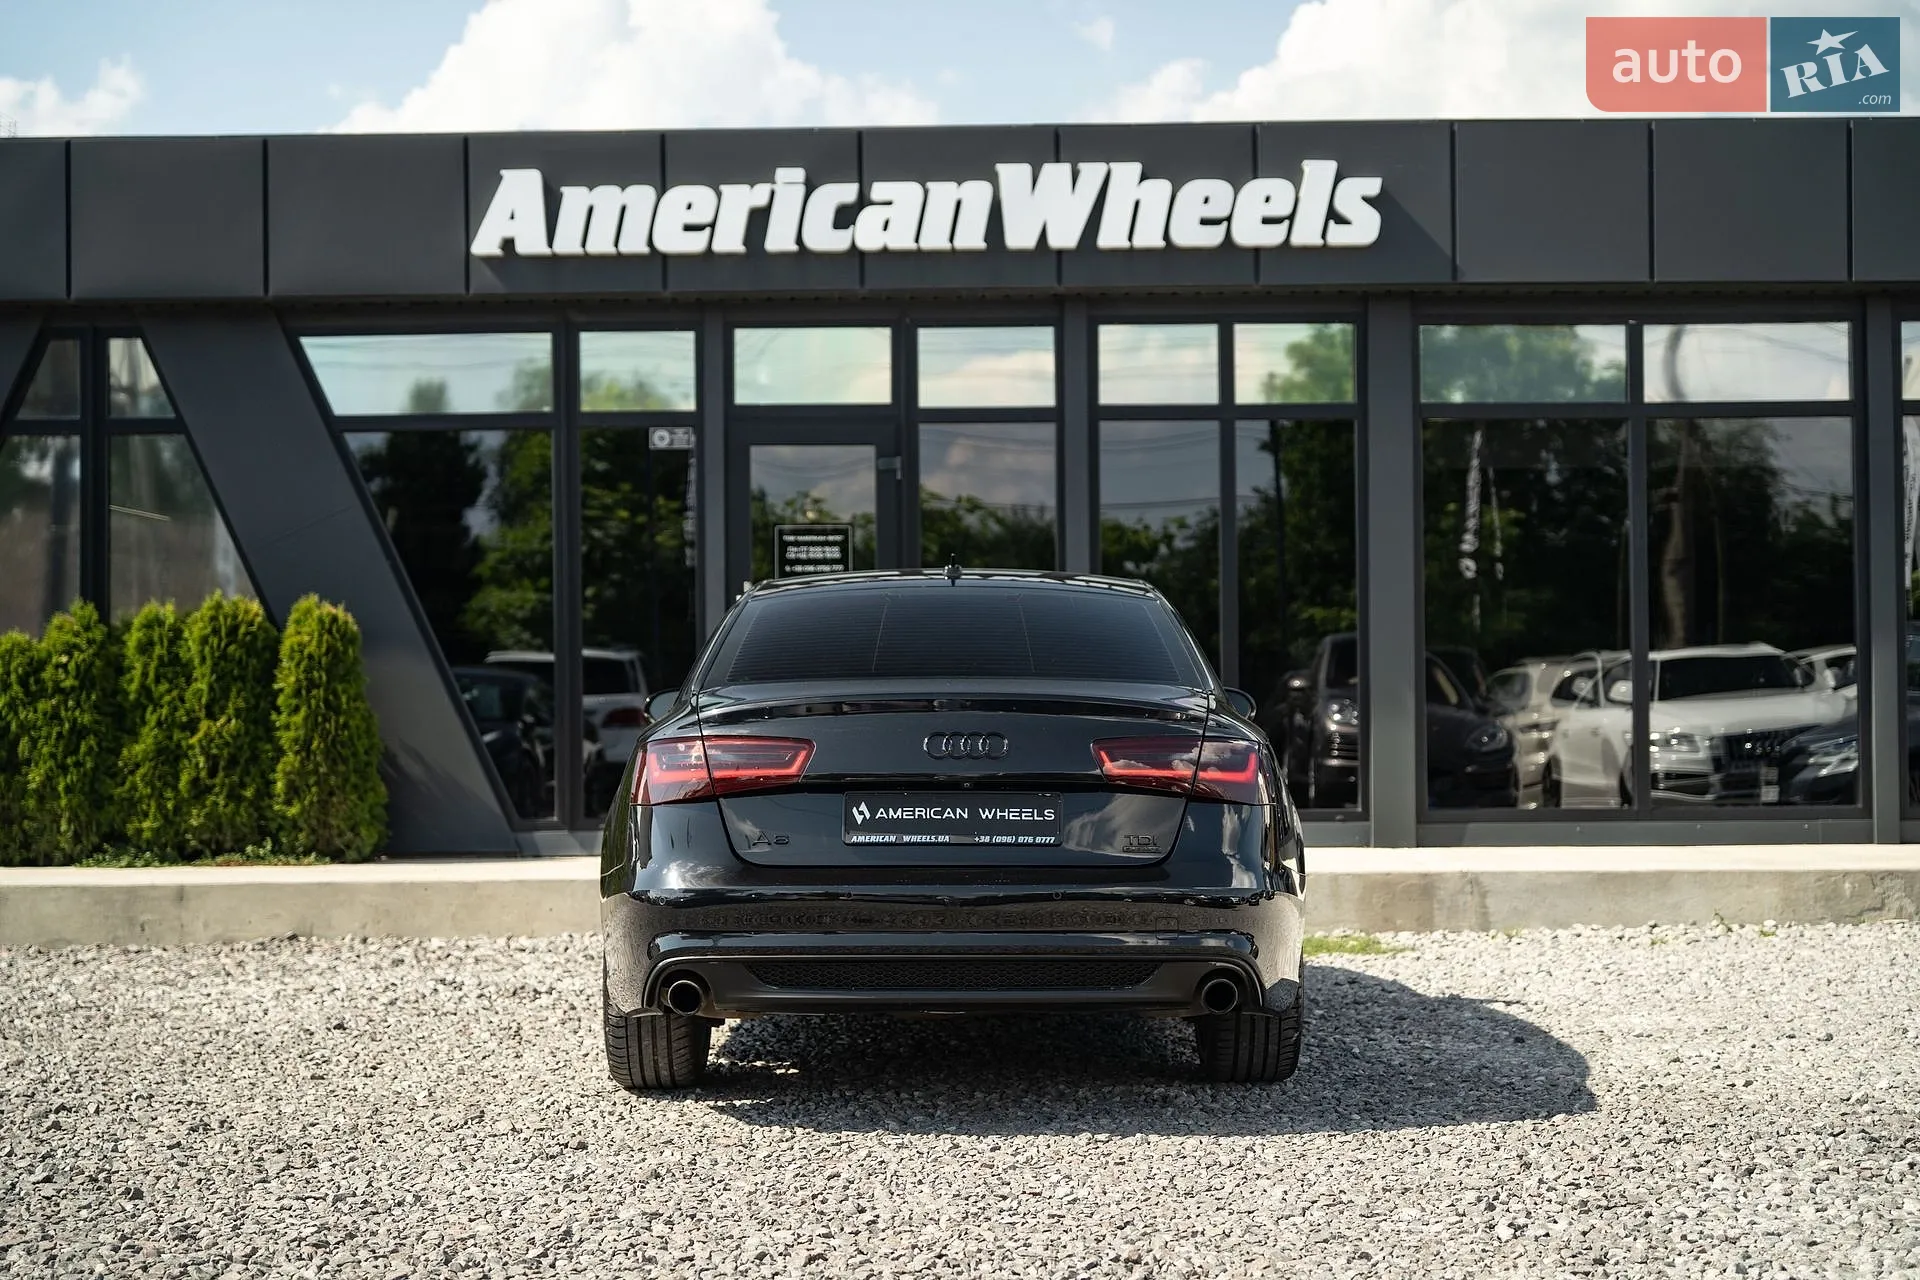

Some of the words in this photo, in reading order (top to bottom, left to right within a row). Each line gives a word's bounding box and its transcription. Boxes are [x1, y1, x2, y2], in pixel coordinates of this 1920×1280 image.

[875, 807, 968, 819] AMERICAN
[978, 808, 1055, 820] WHEELS
[851, 835, 897, 843] AMERICAN
[902, 835, 950, 843] WHEELS.UA
[974, 836, 991, 844] +38
[992, 835, 1016, 844] (096)
[1035, 836, 1056, 844] 0777
[1123, 834, 1158, 846] TDI
